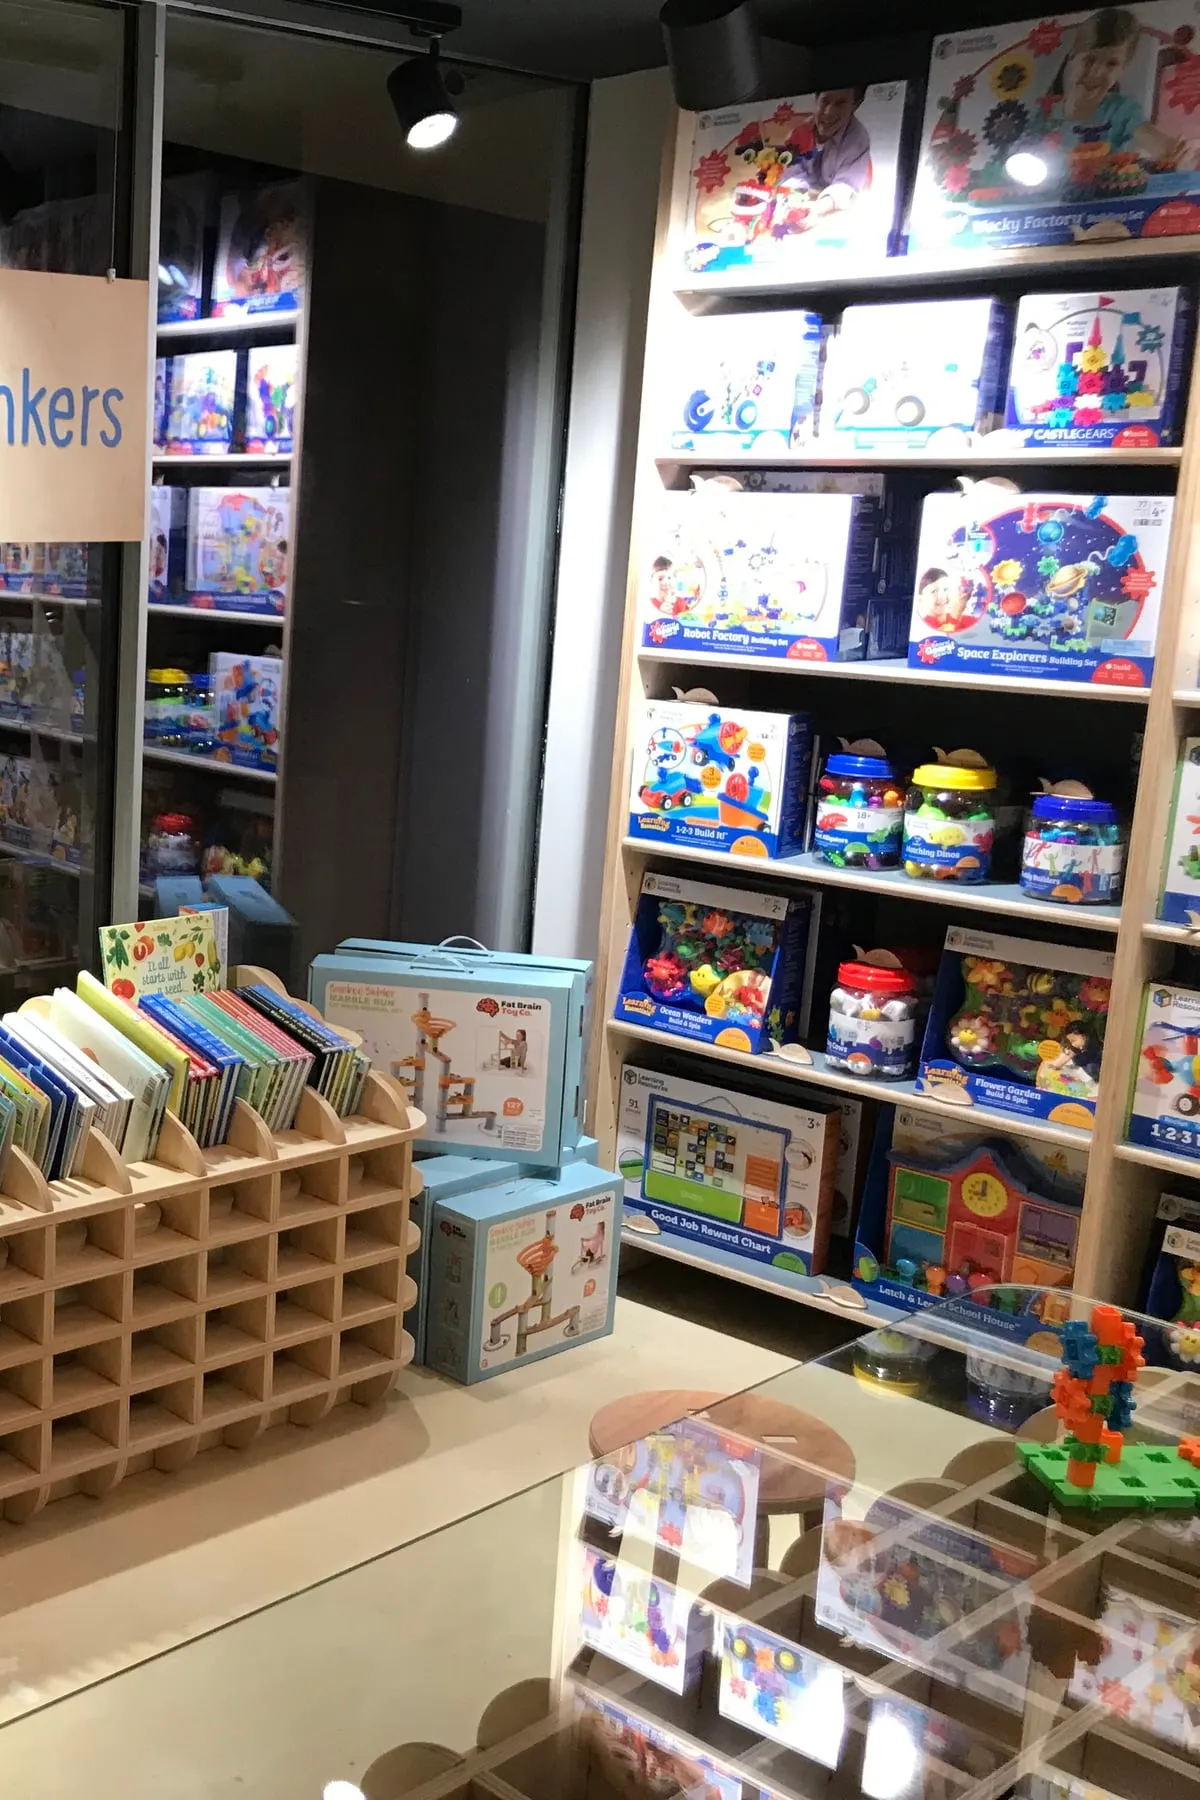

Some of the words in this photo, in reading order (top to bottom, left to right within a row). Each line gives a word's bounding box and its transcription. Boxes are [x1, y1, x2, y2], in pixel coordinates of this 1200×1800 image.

[1023, 211, 1083, 230] Factory
[683, 627, 711, 641] Robot
[712, 629, 750, 646] Factory
[751, 635, 777, 647] Building
[778, 637, 788, 647] Set
[956, 645, 990, 663] Space
[992, 649, 1048, 664] Explorers
[1049, 656, 1084, 668] Building
[1084, 658, 1098, 668] Set
[675, 825, 694, 835] 1-2-3
[694, 827, 716, 838] Build
[936, 849, 961, 859] Dinos
[772, 904, 782, 914] 2+
[147, 961, 155, 972] It
[157, 956, 170, 970] all
[141, 972, 166, 986] starts
[167, 966, 188, 981] with
[500, 1000, 516, 1010] Fat
[517, 1001, 542, 1012] Brain
[500, 1007, 518, 1018] Toy
[518, 1008, 533, 1018] Co.
[659, 1005, 682, 1018] Ocean
[682, 1010, 713, 1027] Wonders
[668, 1016, 684, 1026] Build
[689, 1021, 702, 1031] Spin
[638, 1072, 665, 1086] Learning
[923, 1064, 969, 1084] Learning
[975, 1077, 1005, 1094] Flower
[1007, 1083, 1041, 1101] Garden
[985, 1088, 1003, 1100] Build
[1012, 1094, 1029, 1106] Spin
[628, 1098, 639, 1110] 91
[807, 1118, 822, 1130] 3+
[585, 1200, 596, 1209] Fat
[596, 1196, 612, 1206] Brain
[650, 1208, 678, 1227] Good
[679, 1217, 700, 1232] Job
[701, 1224, 740, 1244] Reward
[740, 1237, 772, 1254] Chart
[878, 1284, 906, 1301] Latch
[948, 1302, 982, 1320] School
